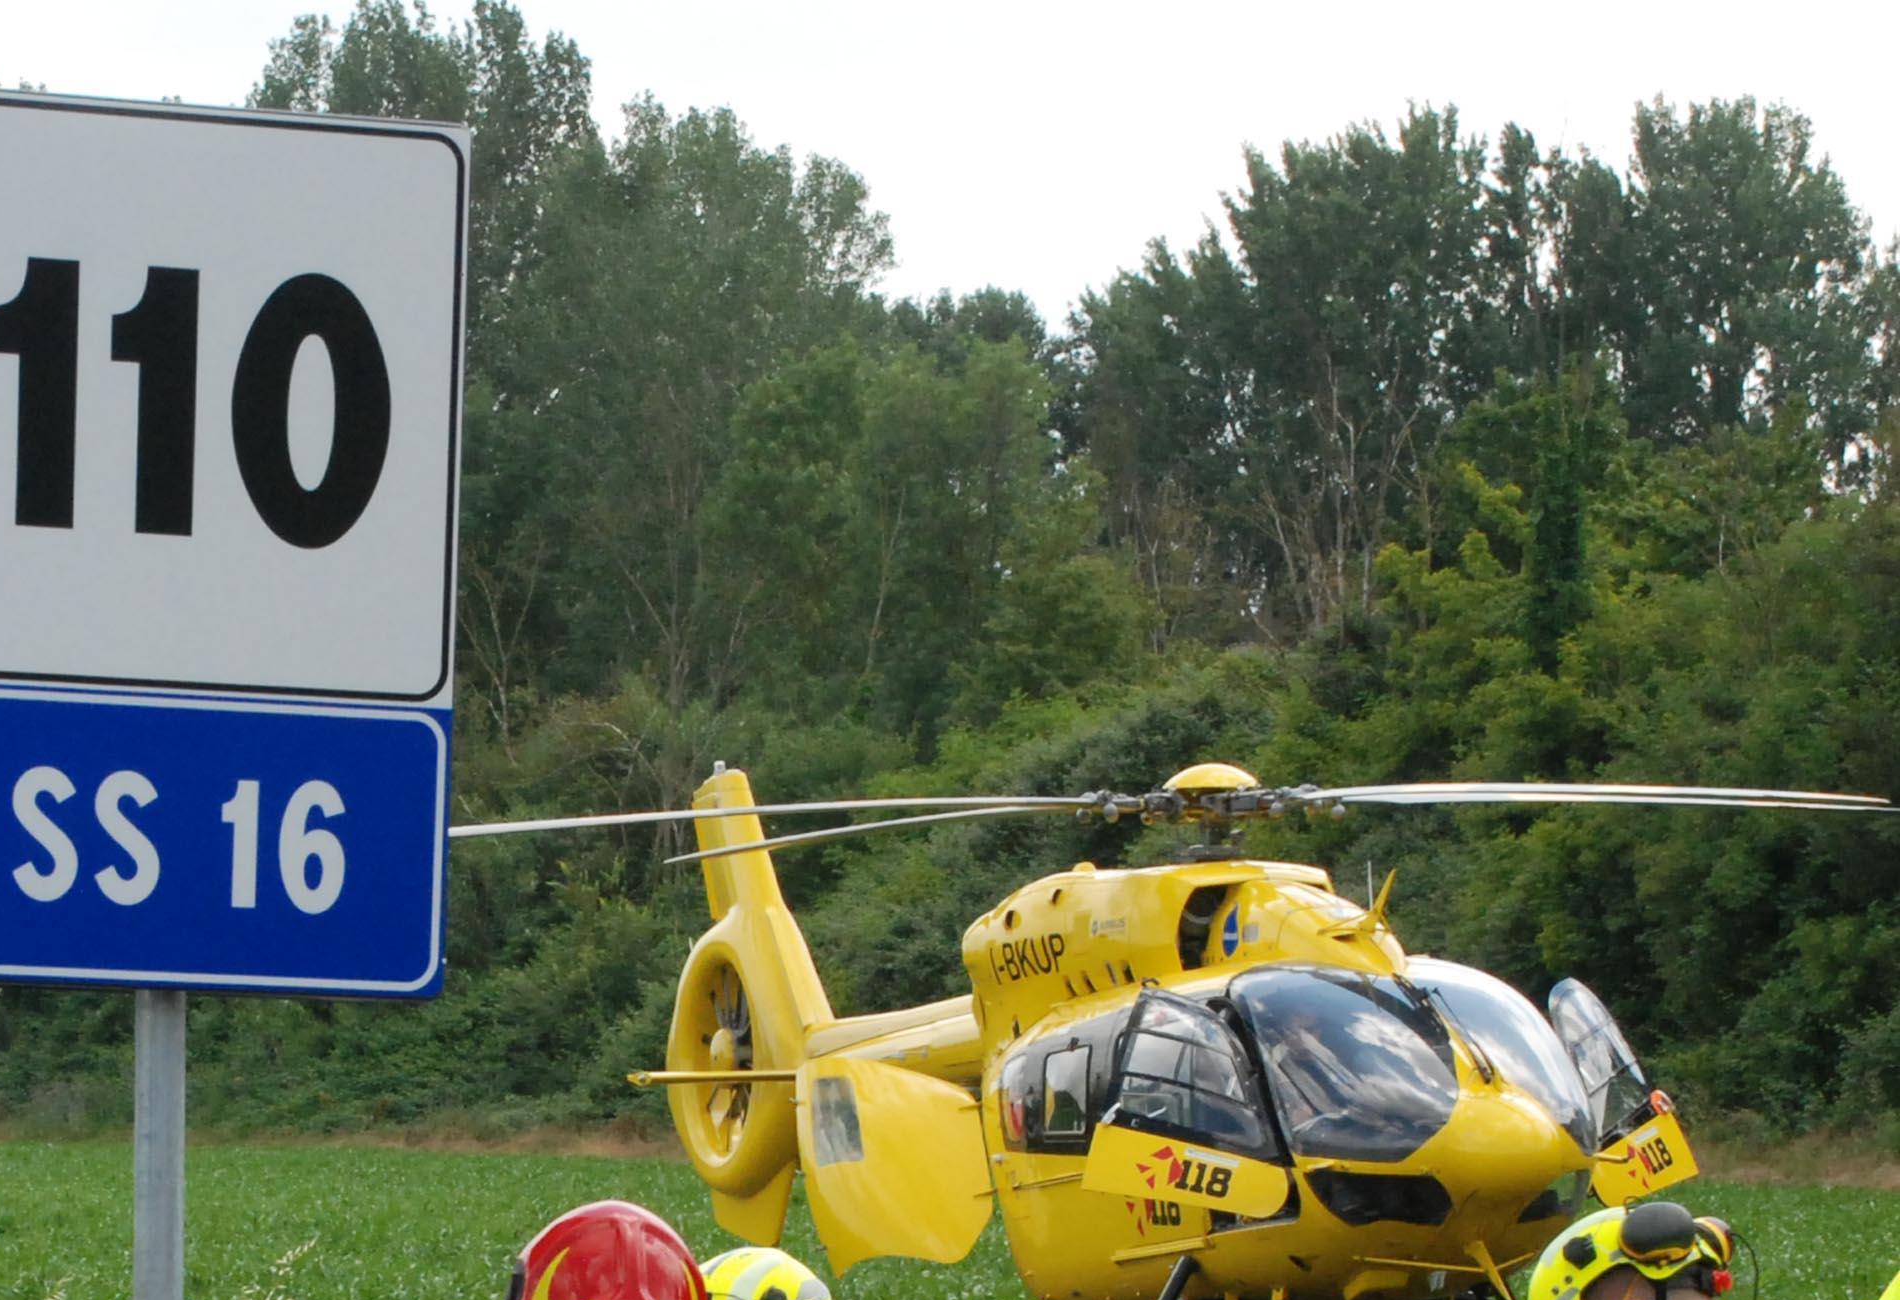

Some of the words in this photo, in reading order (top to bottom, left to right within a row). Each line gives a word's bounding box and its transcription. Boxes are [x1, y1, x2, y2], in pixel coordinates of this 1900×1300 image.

[11, 765, 161, 906] SS
[220, 779, 347, 916] 16
[989, 933, 1066, 985] I-BKUP
[1174, 1159, 1233, 1198] 118
[1641, 1137, 1673, 1175] 118
